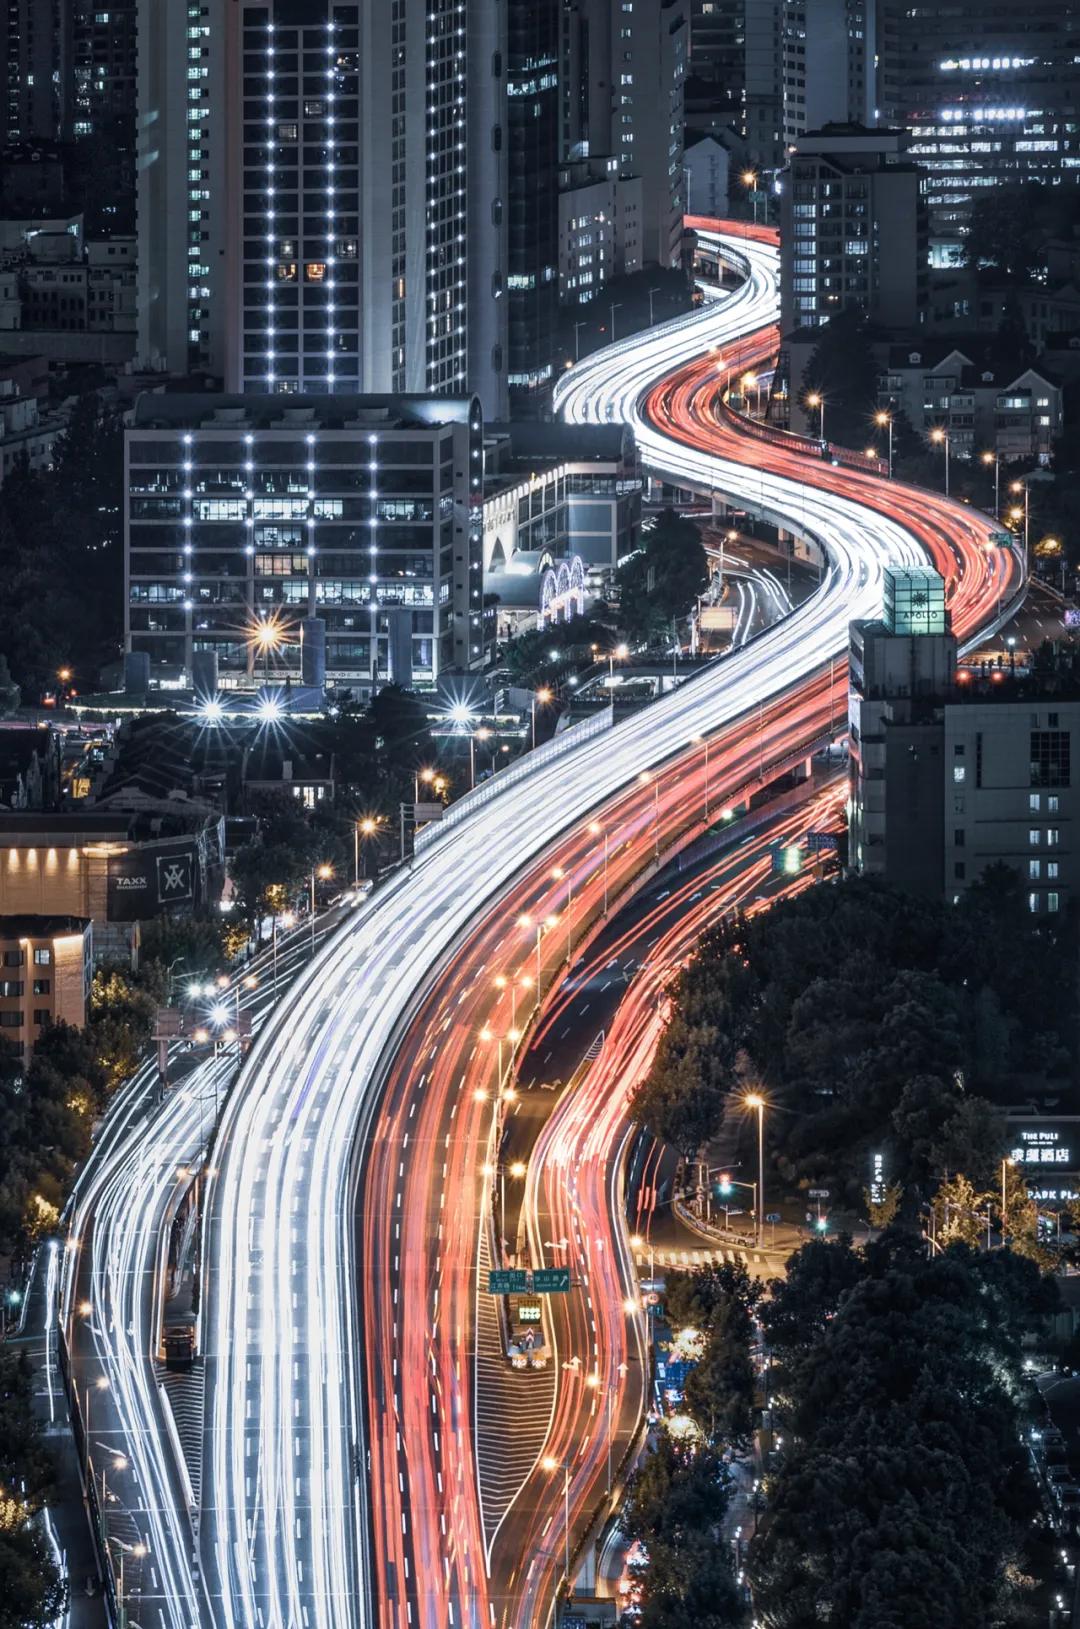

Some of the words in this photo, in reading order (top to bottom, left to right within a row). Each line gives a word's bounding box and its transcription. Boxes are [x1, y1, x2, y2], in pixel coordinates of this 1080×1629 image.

[117, 877, 147, 885] TAXX
[1039, 1132, 1059, 1140] PULI
[1027, 1190, 1056, 1200] PARK
